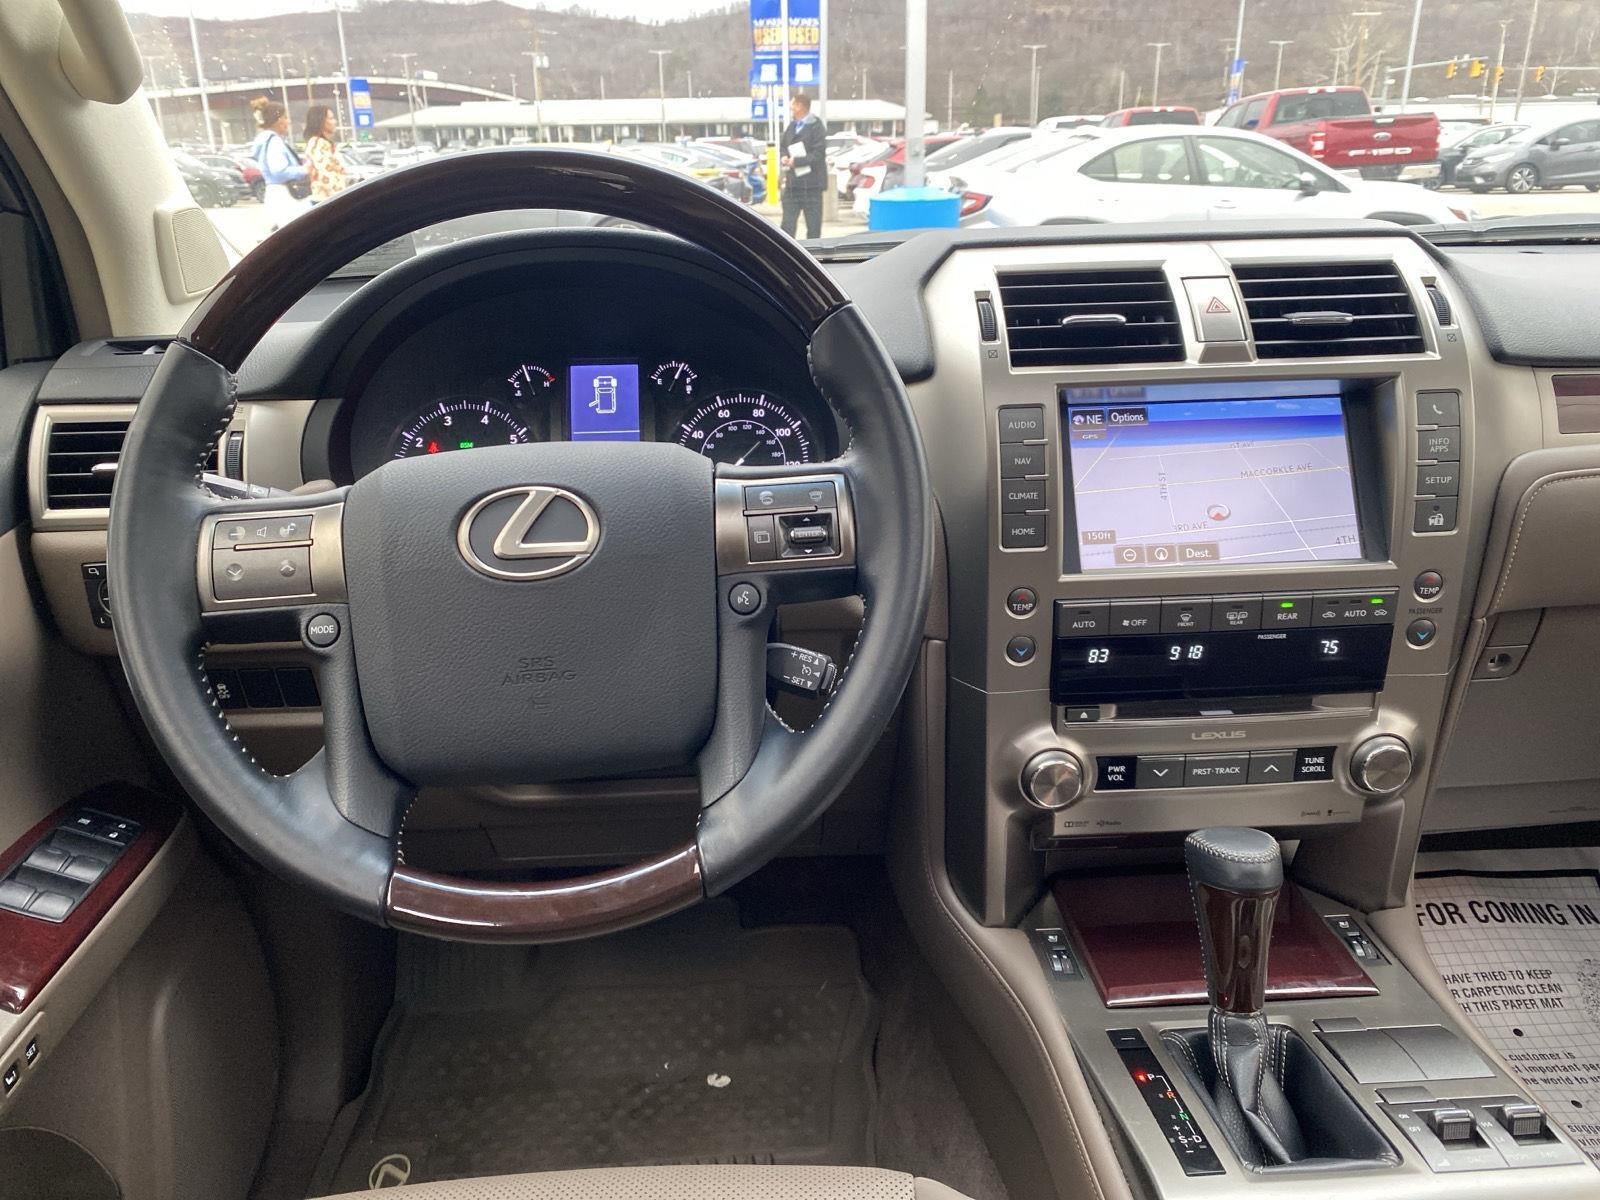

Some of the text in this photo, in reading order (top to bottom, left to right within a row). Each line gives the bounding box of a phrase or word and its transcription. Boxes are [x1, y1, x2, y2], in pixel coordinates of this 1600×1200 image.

[717, 409, 731, 418] 60
[752, 408, 765, 418] 80
[1110, 412, 1145, 424] Options
[443, 415, 453, 426] 3
[480, 414, 489, 425] 4
[1086, 414, 1103, 425] NE
[1008, 421, 1037, 429] AUDIO
[691, 430, 705, 440] 40
[775, 428, 791, 437] 100
[415, 437, 424, 448] 2
[510, 434, 518, 445] 5
[1429, 437, 1450, 446] INFO
[1430, 445, 1449, 453] APPS
[1014, 457, 1032, 465] NAV
[1296, 462, 1313, 472] AVE
[1425, 475, 1453, 484] SETUP
[1008, 491, 1039, 500] CLIMATE
[1011, 527, 1036, 536] HOME
[1087, 531, 1112, 541] 150ft
[1186, 547, 1213, 559] Dest.
[1420, 585, 1440, 595] TEMP
[1012, 602, 1034, 612] TEMP
[1408, 606, 1444, 616] PASSENGER
[1277, 611, 1298, 621] REAR
[1344, 609, 1367, 618] AUTO
[1072, 620, 1096, 629] AUTO
[1131, 618, 1149, 627] OFF
[310, 625, 336, 635] MODE
[1257, 632, 1287, 640] PASSENGER
[1321, 639, 1340, 655] 75
[799, 653, 813, 663] RES
[1087, 648, 1110, 664] 83
[518, 656, 555, 669] SRS
[501, 669, 577, 686] AIRBAG
[791, 675, 806, 686] SET
[1191, 730, 1247, 741] LEXUS
[1304, 756, 1325, 765] TUNE
[1107, 765, 1126, 774] PWR
[1301, 764, 1326, 773] SCROLL
[1107, 774, 1125, 782] VOL
[1415, 900, 1600, 927] FOR COMING IN
[1442, 969, 1553, 985] HAVE TRIED TO KEEP
[1462, 985, 1525, 999] CARPETING
[1528, 983, 1564, 994] CLEAN
[1473, 1000, 1500, 1012] THIS
[1504, 999, 1539, 1010] PAPER
[1541, 997, 1564, 1008] MAT
[1508, 1052, 1576, 1061] customer is
[1521, 1063, 1581, 1074] important
[1146, 1073, 1155, 1081] P
[1540, 1076, 1574, 1085] world
[1574, 1076, 1588, 1085] to
[1166, 1091, 1175, 1100] R
[1179, 1112, 1190, 1121] N
